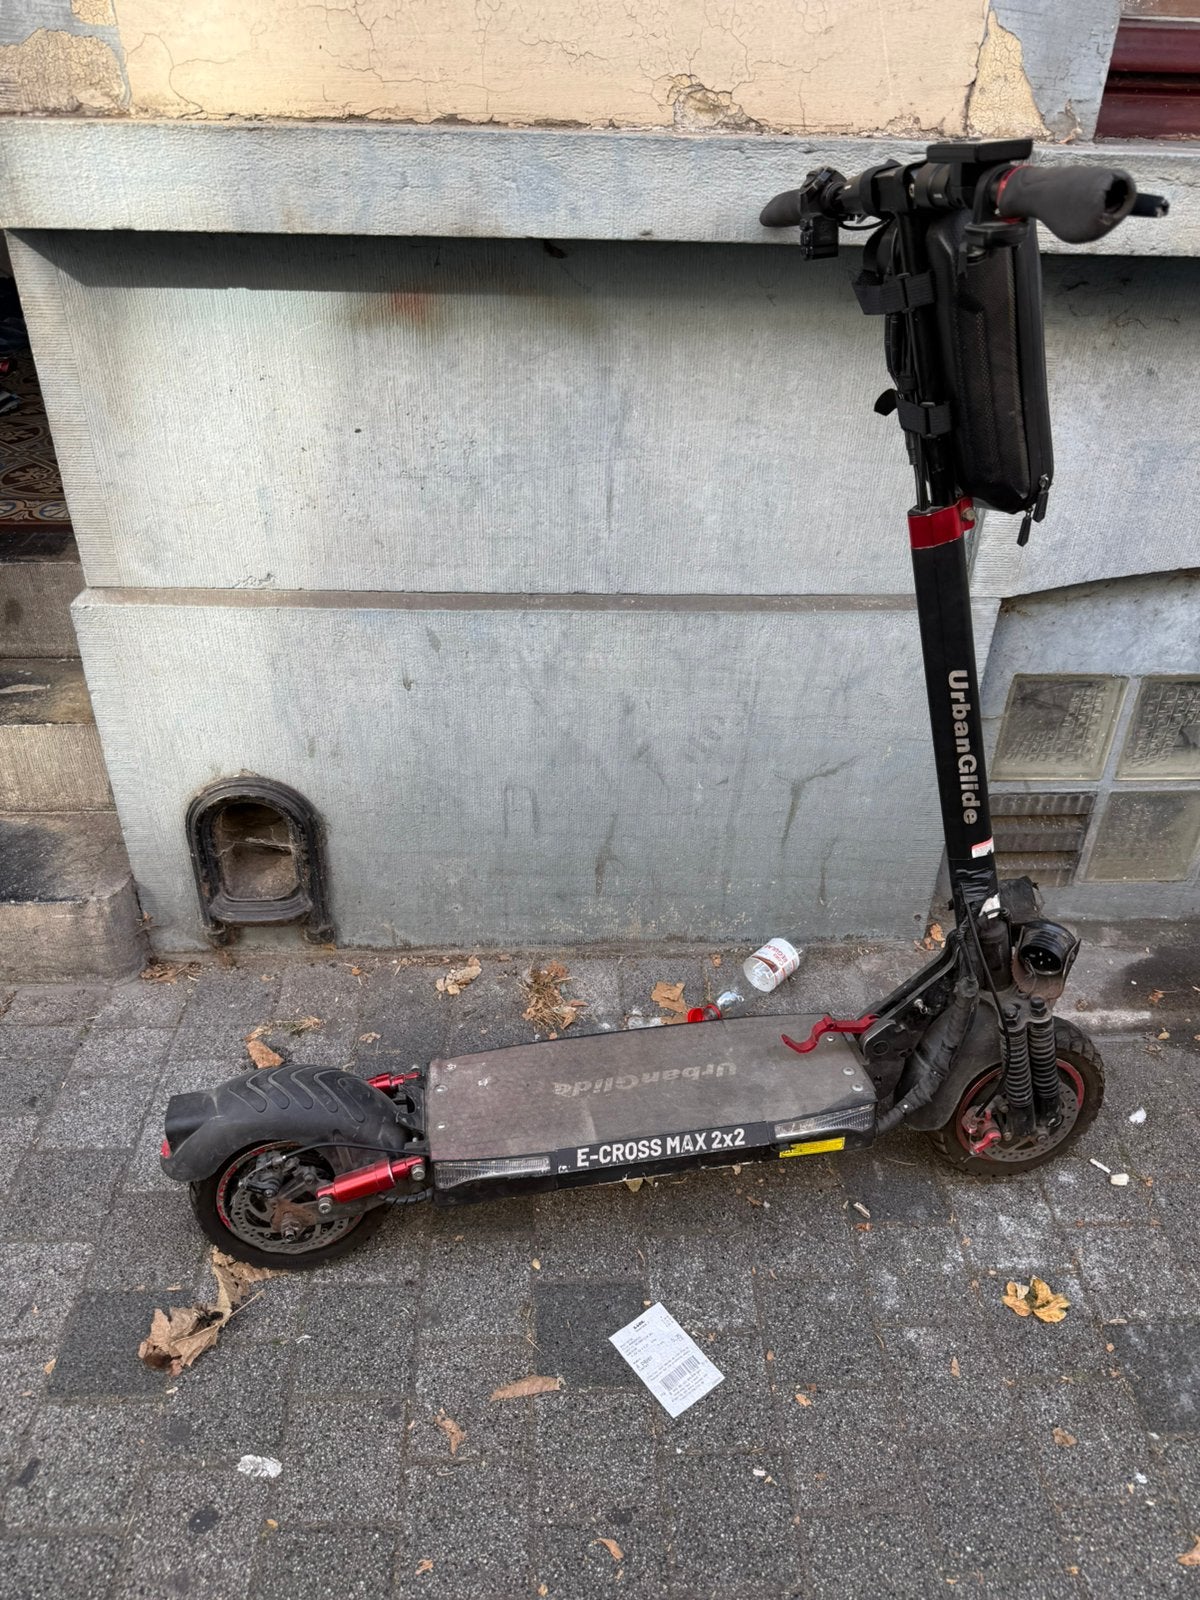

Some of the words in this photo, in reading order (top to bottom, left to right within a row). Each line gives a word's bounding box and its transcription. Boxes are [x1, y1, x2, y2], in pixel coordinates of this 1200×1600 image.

[948, 669, 981, 825] UrbanGlide
[576, 1138, 662, 1167] E-CROSS
[666, 1132, 708, 1155] MAX
[711, 1127, 746, 1149] 2x2
